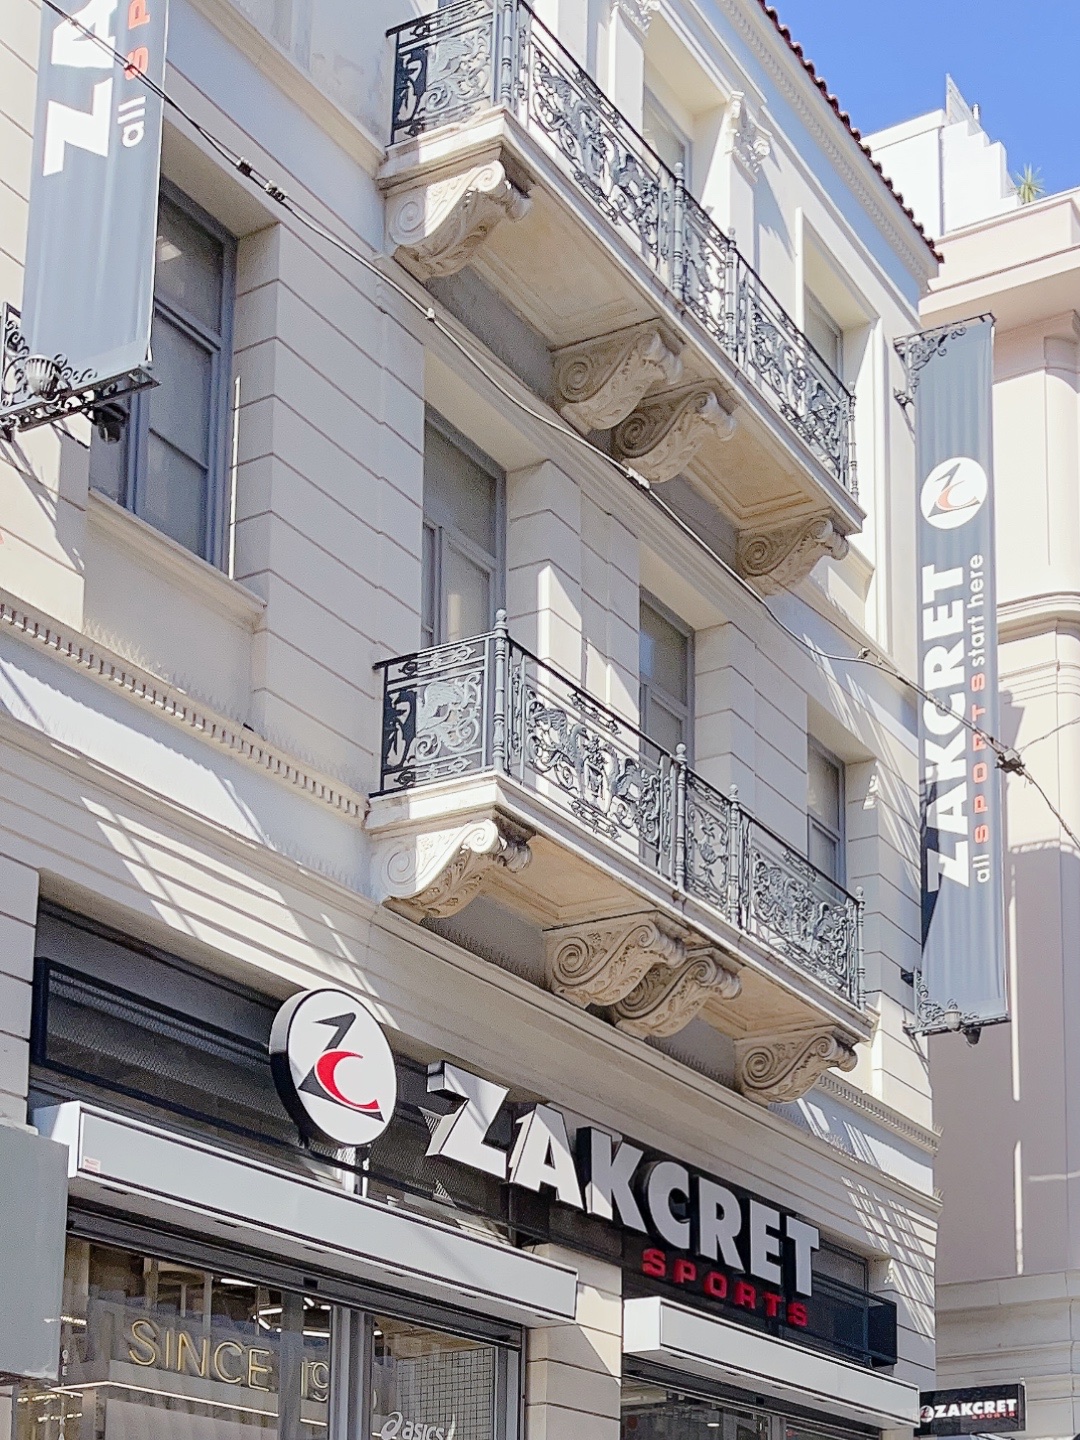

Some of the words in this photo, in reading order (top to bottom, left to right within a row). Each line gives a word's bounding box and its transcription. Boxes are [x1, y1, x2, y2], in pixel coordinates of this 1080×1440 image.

[117, 96, 146, 147] all
[967, 554, 984, 610] here
[968, 615, 985, 667] start
[922, 564, 969, 892] ZAKCRET
[970, 672, 990, 844] SPORTS
[973, 854, 990, 883] all
[427, 1060, 820, 1297] ZAKCRET
[642, 1248, 808, 1327] SPORTS
[128, 1319, 273, 1392] SINCE
[934, 1398, 1017, 1418] ZAKCRET
